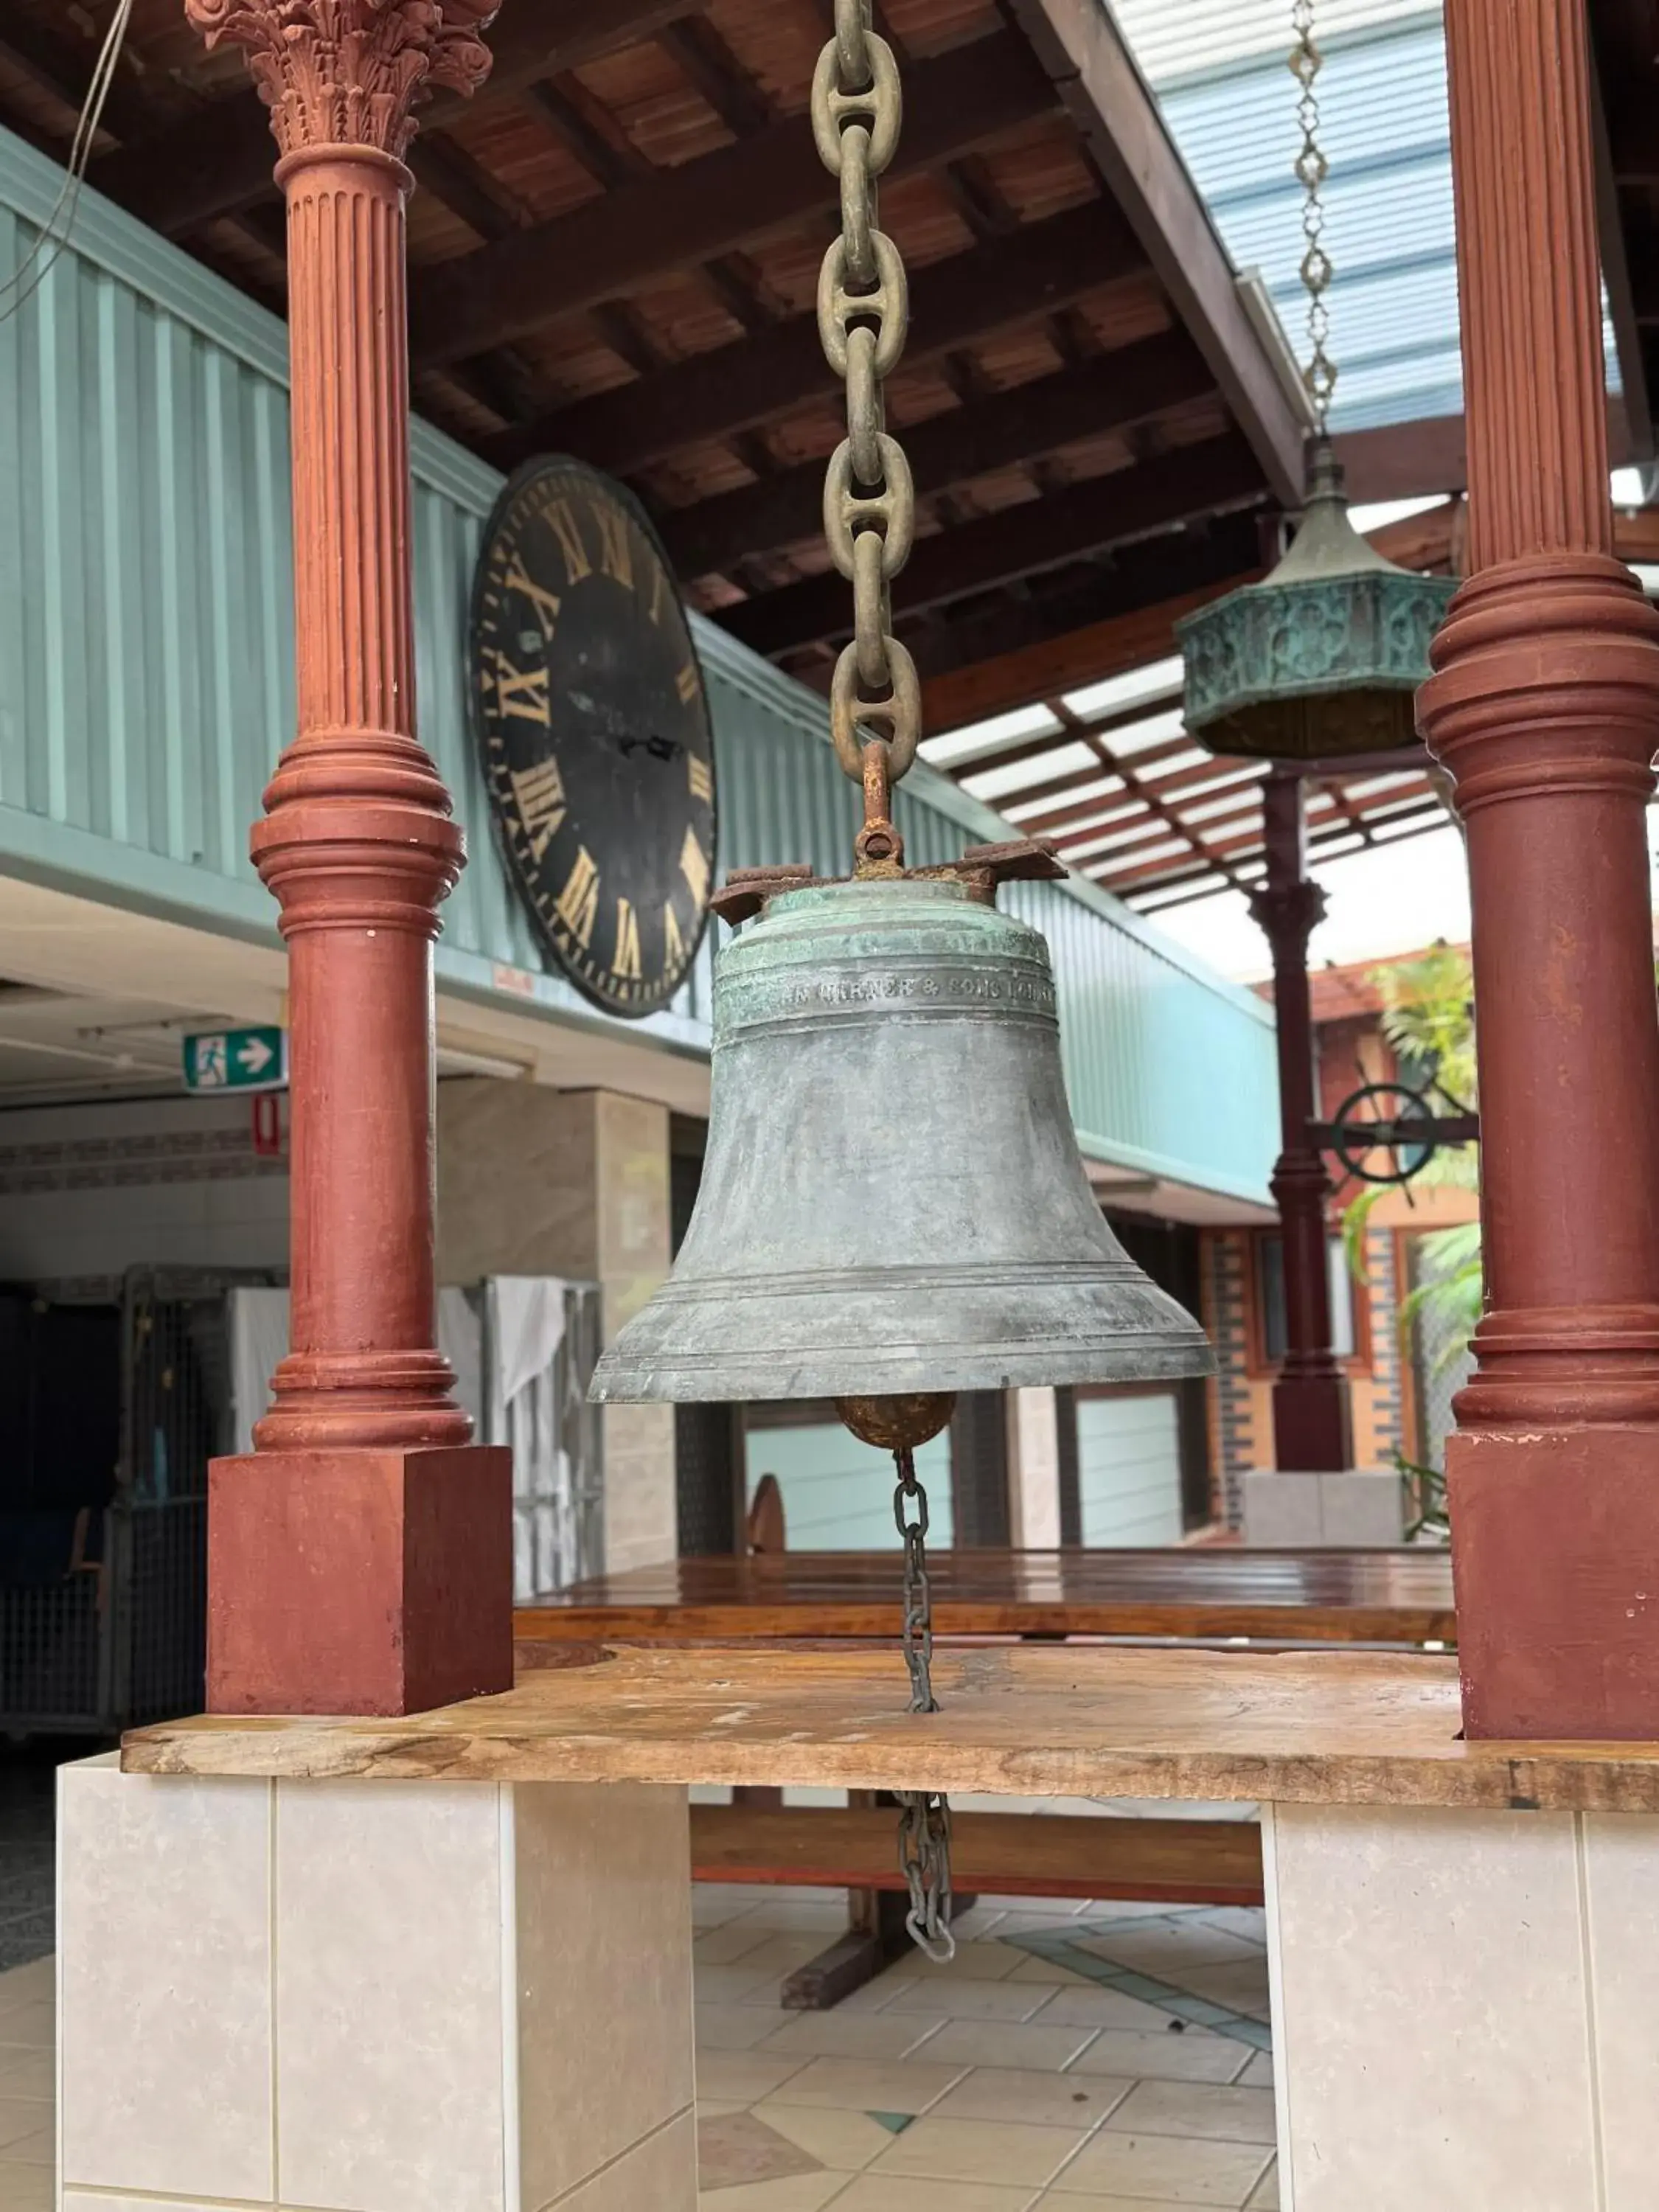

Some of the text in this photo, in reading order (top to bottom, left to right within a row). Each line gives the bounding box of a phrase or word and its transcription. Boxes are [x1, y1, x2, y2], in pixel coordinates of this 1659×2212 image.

[505, 549, 561, 642] X
[497, 651, 552, 728] IX
[510, 754, 567, 864] VIII
[611, 897, 643, 979] VI
[922, 975, 940, 996] &
[948, 977, 1001, 999] SONS
